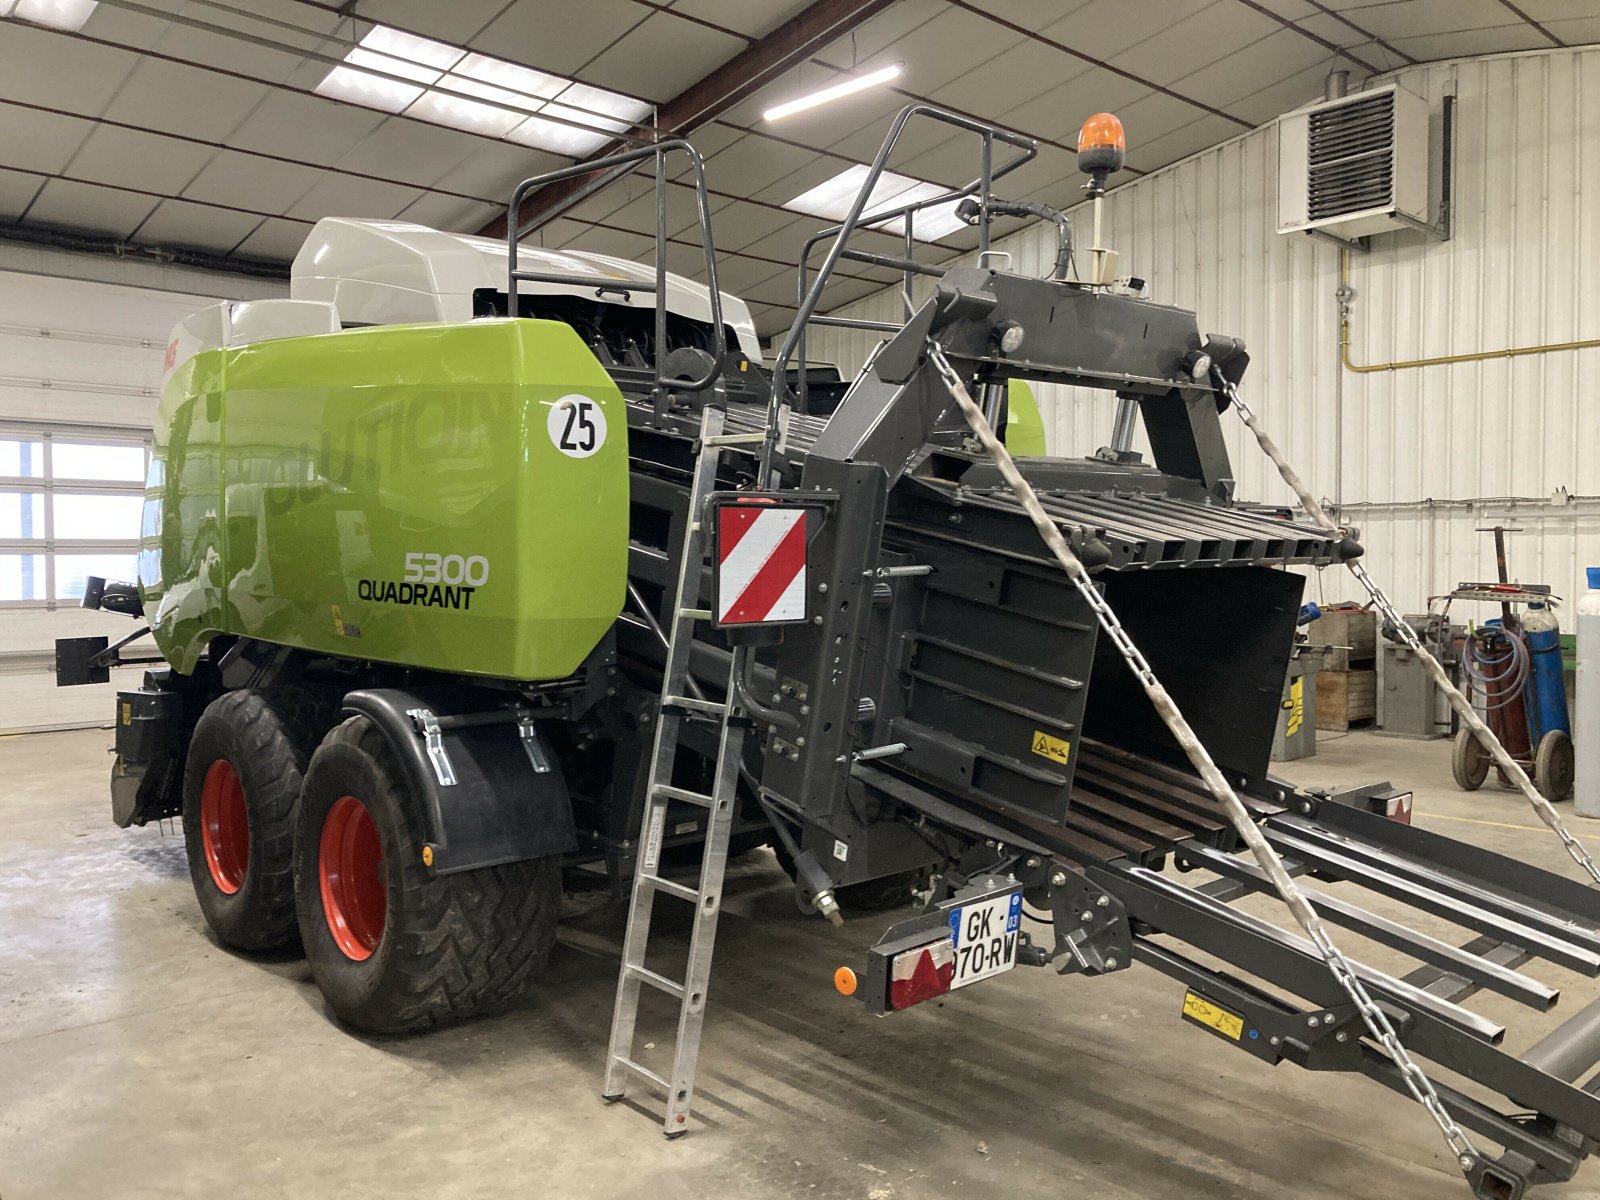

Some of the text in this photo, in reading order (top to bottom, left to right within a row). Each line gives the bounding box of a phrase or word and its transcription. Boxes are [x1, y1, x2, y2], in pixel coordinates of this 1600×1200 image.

[560, 401, 595, 451] 25
[404, 552, 490, 587] 5300
[358, 579, 475, 610] QUADRANT
[1007, 914, 1018, 930] 03
